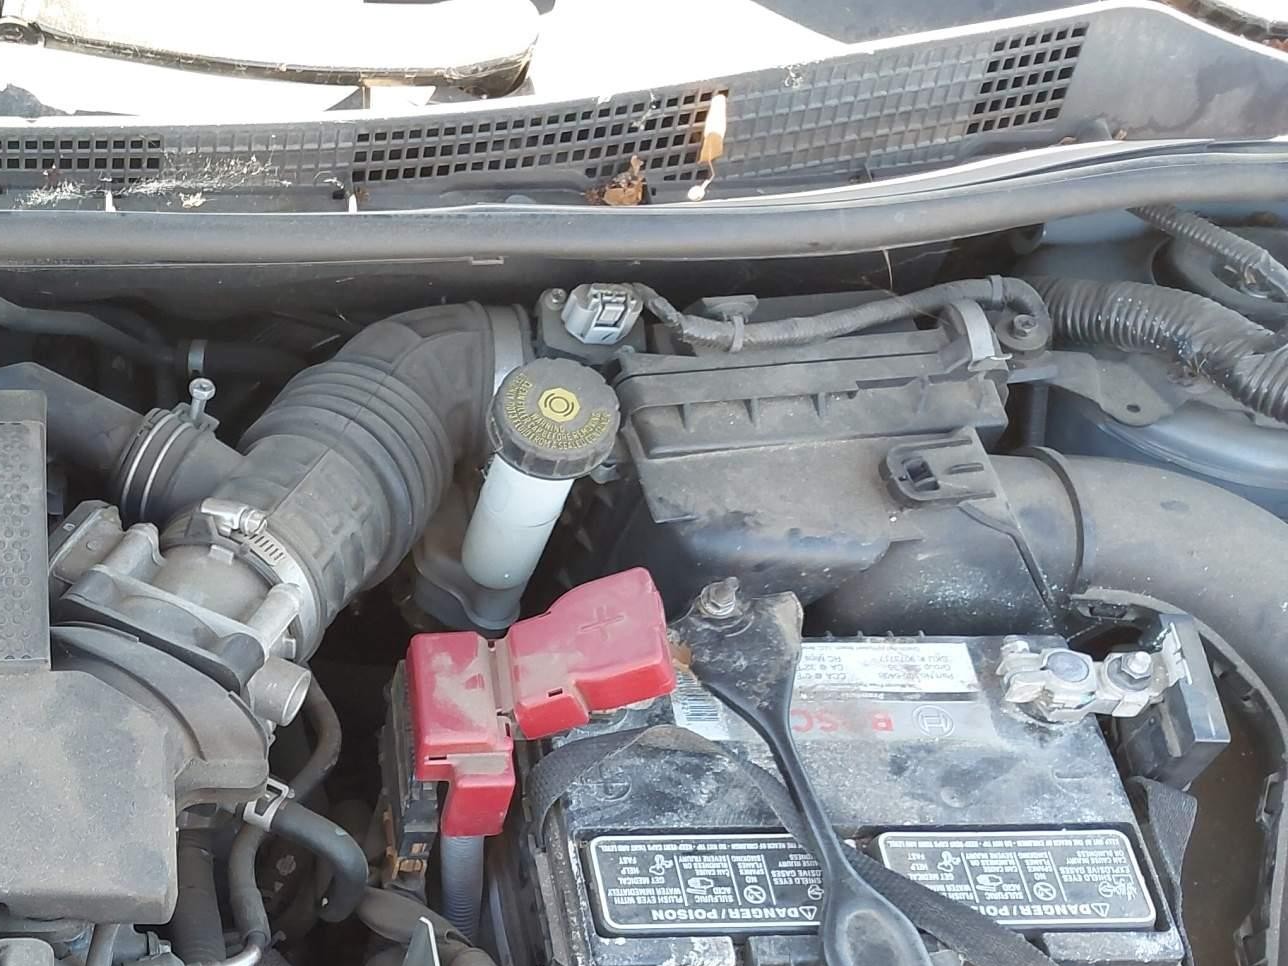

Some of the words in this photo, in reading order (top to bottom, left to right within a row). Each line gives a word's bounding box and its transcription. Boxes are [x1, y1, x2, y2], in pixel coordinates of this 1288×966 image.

[529, 413, 565, 432] WARNING
[526, 421, 543, 435] CAP
[539, 429, 572, 441] BEFORE
[528, 433, 550, 446] FROM
[621, 867, 639, 875] HELP
[1059, 866, 1085, 874] GASES
[618, 876, 649, 884] MEDICAL
[651, 876, 665, 884] GET
[1034, 872, 1046, 880] NO
[1062, 874, 1082, 882] EYES
[773, 877, 793, 885] EYES
[608, 888, 654, 896] IMMEDIATELY
[656, 888, 681, 896] WATER
[984, 892, 1024, 900] SULFURIC
[614, 896, 635, 904] WITH
[636, 896, 656, 904] EYES
[658, 896, 684, 904] FLUSH
[651, 908, 718, 919] POISON
[728, 908, 799, 919] DANGER
[1019, 904, 1091, 916] DANGER
